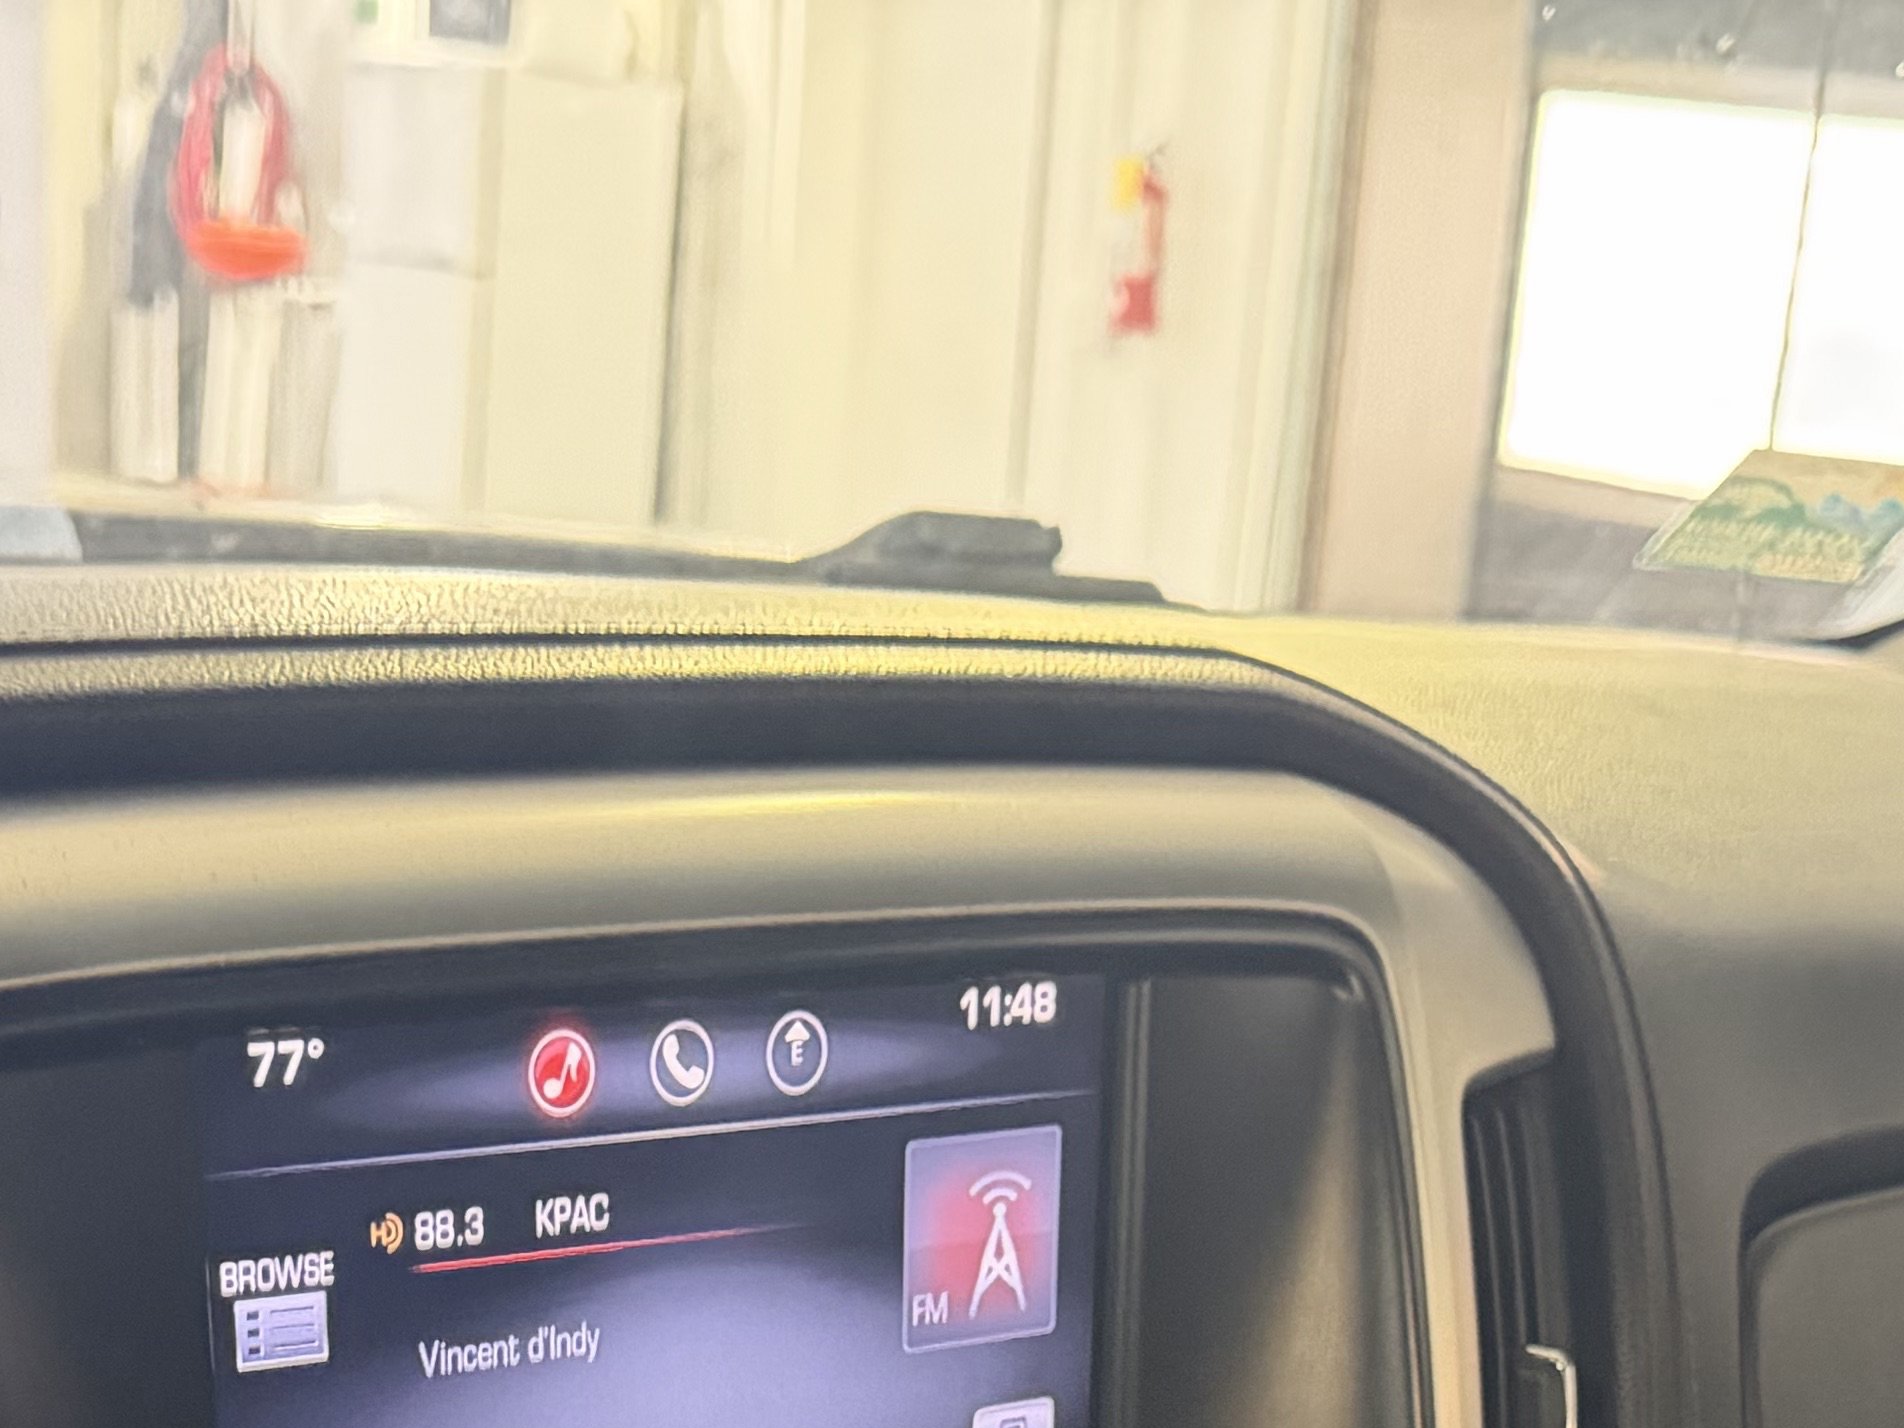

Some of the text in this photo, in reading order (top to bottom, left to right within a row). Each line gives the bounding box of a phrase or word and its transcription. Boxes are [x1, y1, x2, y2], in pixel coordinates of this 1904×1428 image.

[960, 982, 1057, 1030] 11:48
[248, 1038, 324, 1087] 77°
[415, 1207, 484, 1250] 88.3
[535, 1192, 611, 1238] KPAC
[220, 1251, 335, 1298] BROWSE
[913, 1291, 948, 1326] FM
[419, 1321, 601, 1377] Vincent d'Indy
